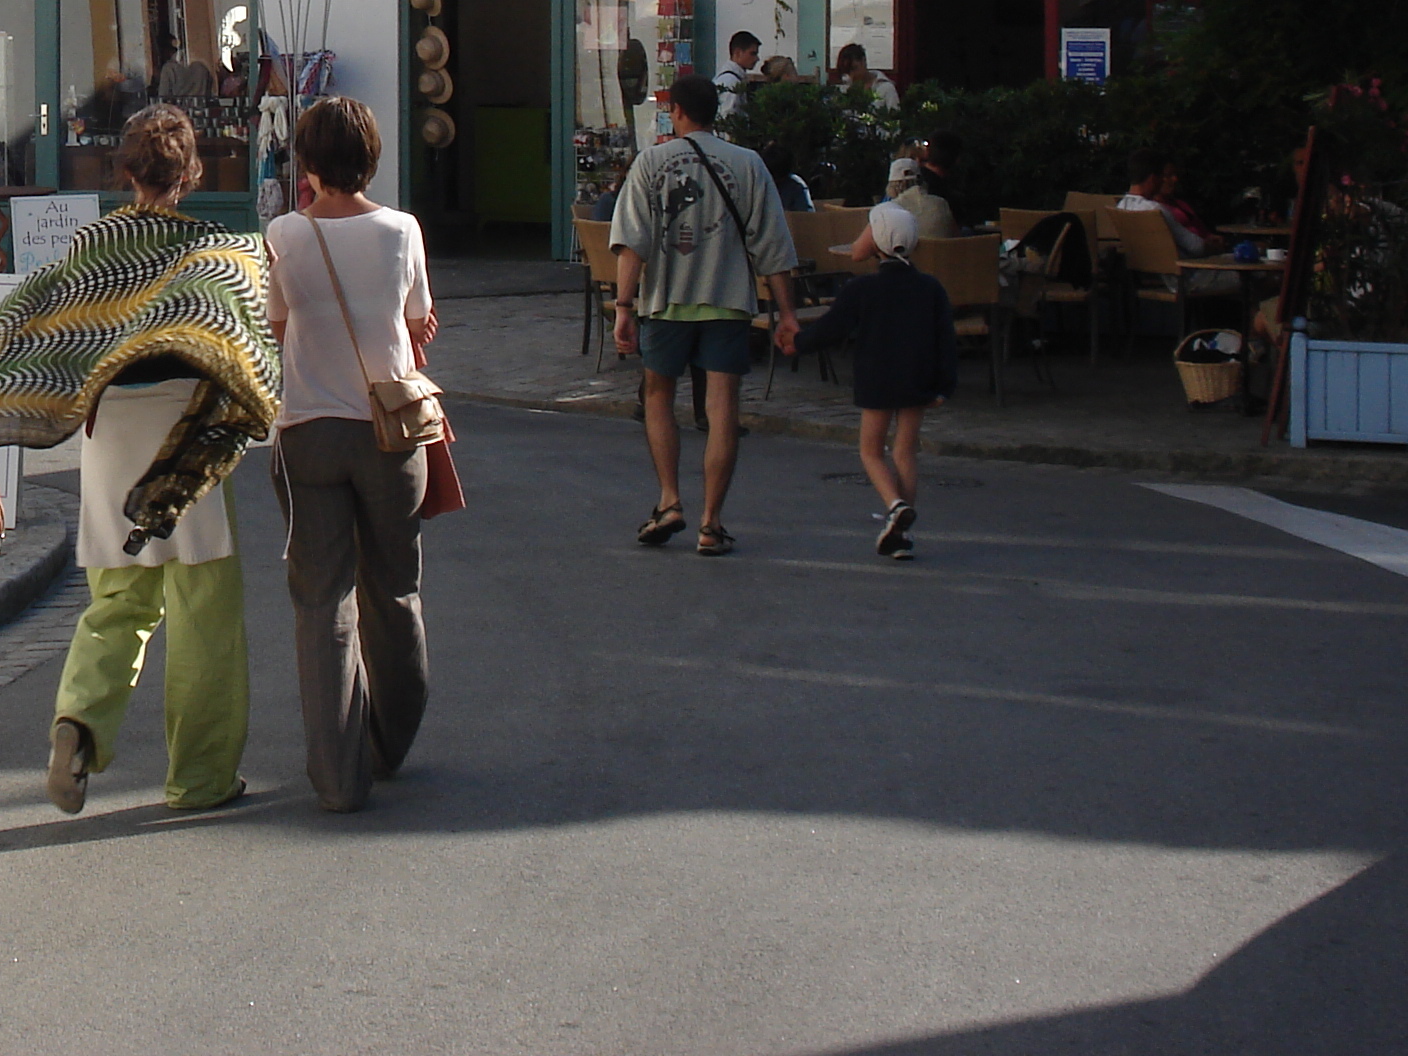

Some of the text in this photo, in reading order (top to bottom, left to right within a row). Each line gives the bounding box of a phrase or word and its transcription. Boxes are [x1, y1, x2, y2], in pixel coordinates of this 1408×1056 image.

[45, 200, 69, 214] Au
[36, 213, 79, 233] jardin
[22, 230, 74, 249] des per
